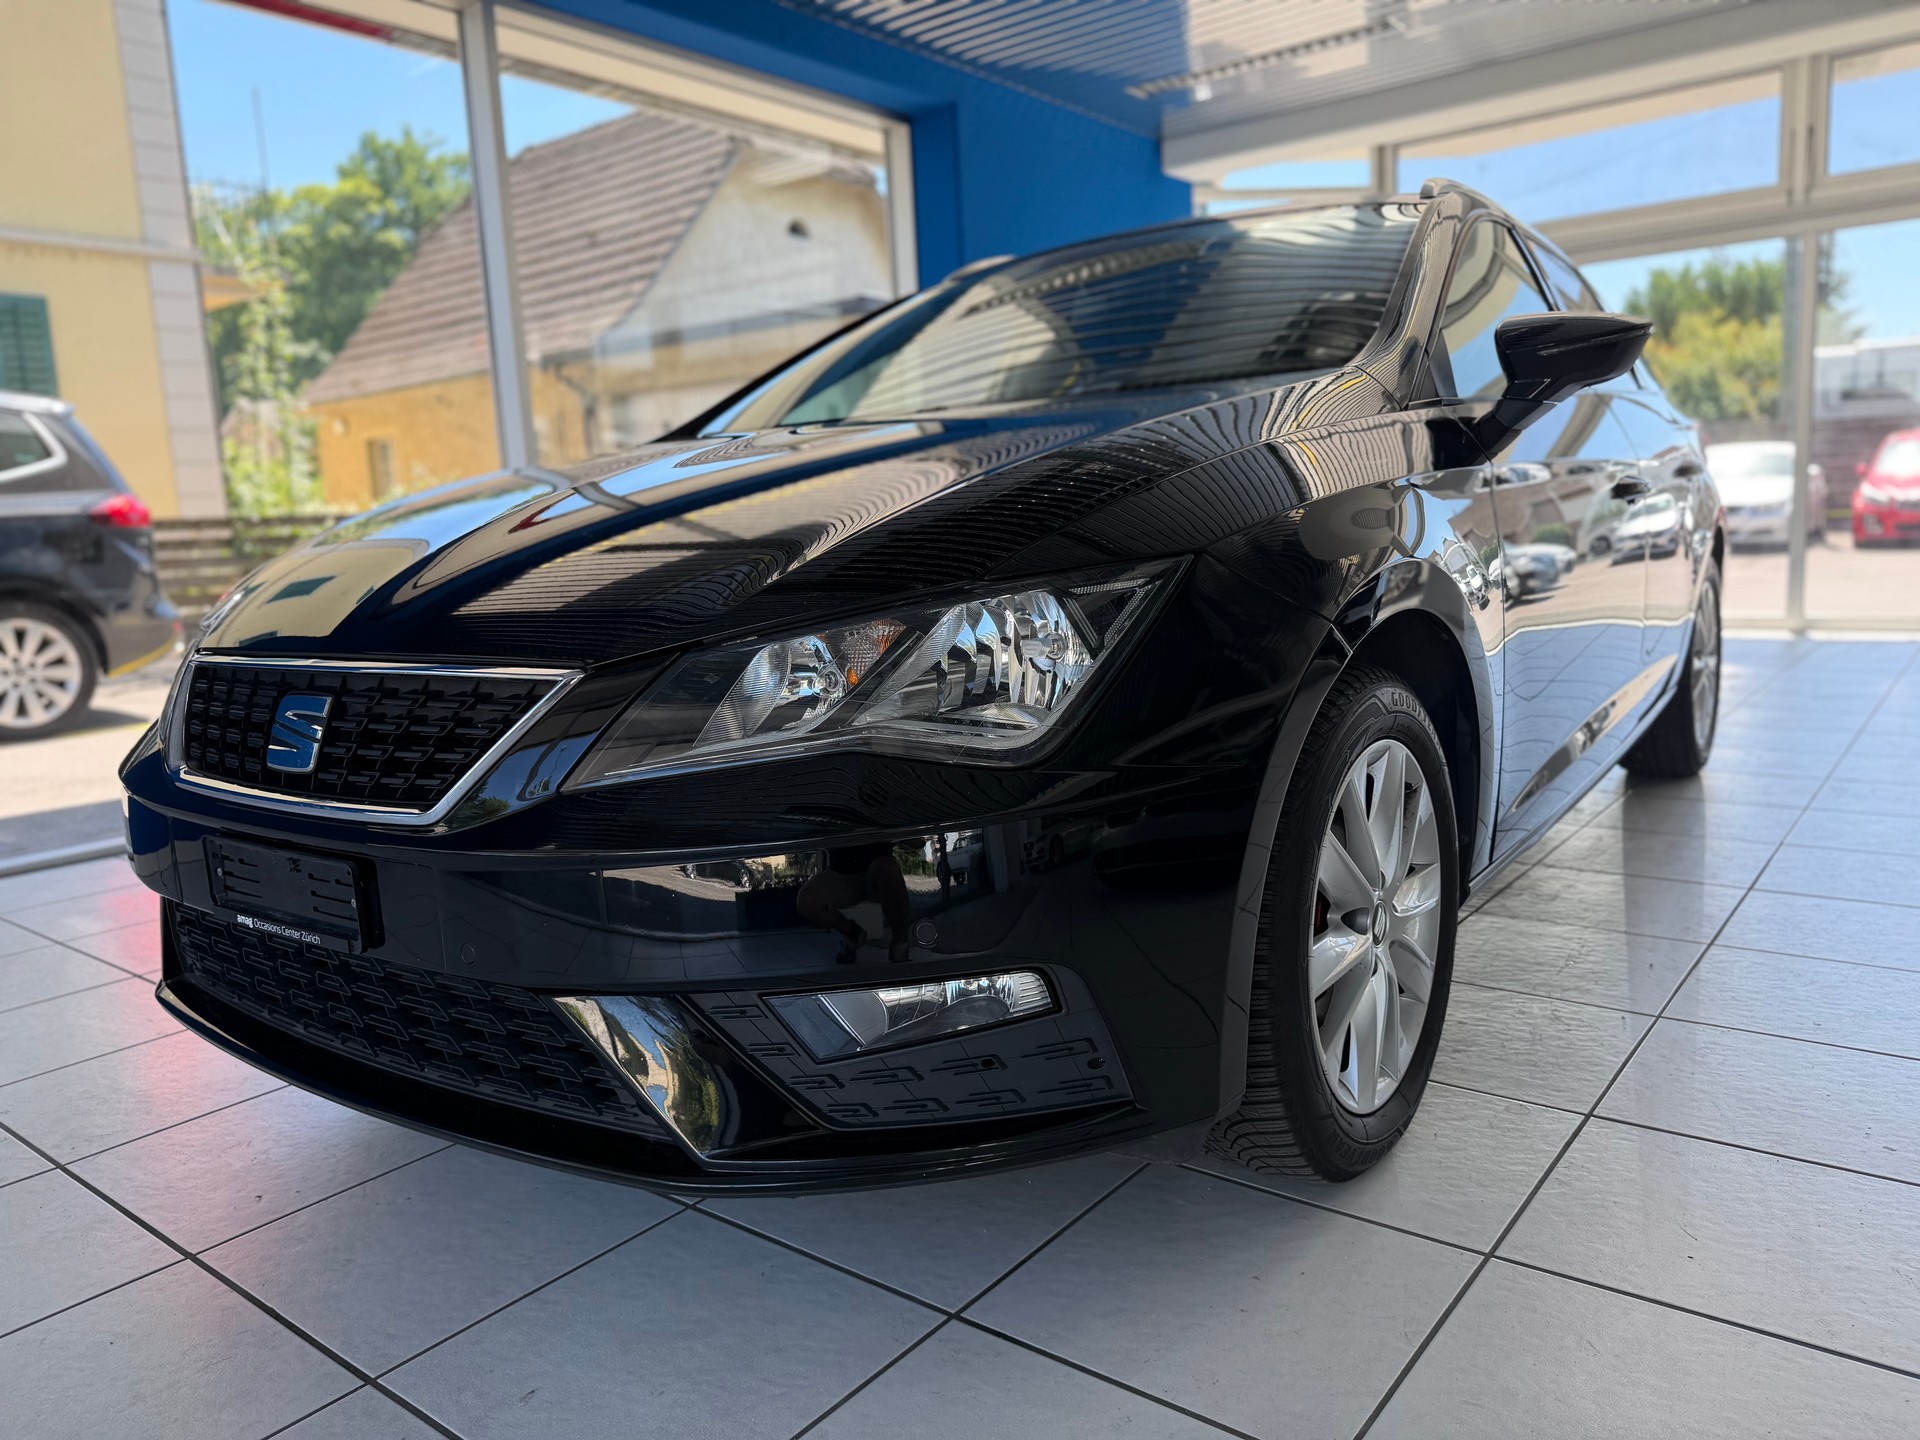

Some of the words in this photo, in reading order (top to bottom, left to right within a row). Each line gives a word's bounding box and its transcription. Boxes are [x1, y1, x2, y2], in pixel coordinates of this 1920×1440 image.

[236, 914, 253, 928] amag
[254, 918, 281, 933] Occasions
[282, 926, 300, 939] Center
[301, 931, 321, 944] Zürich
